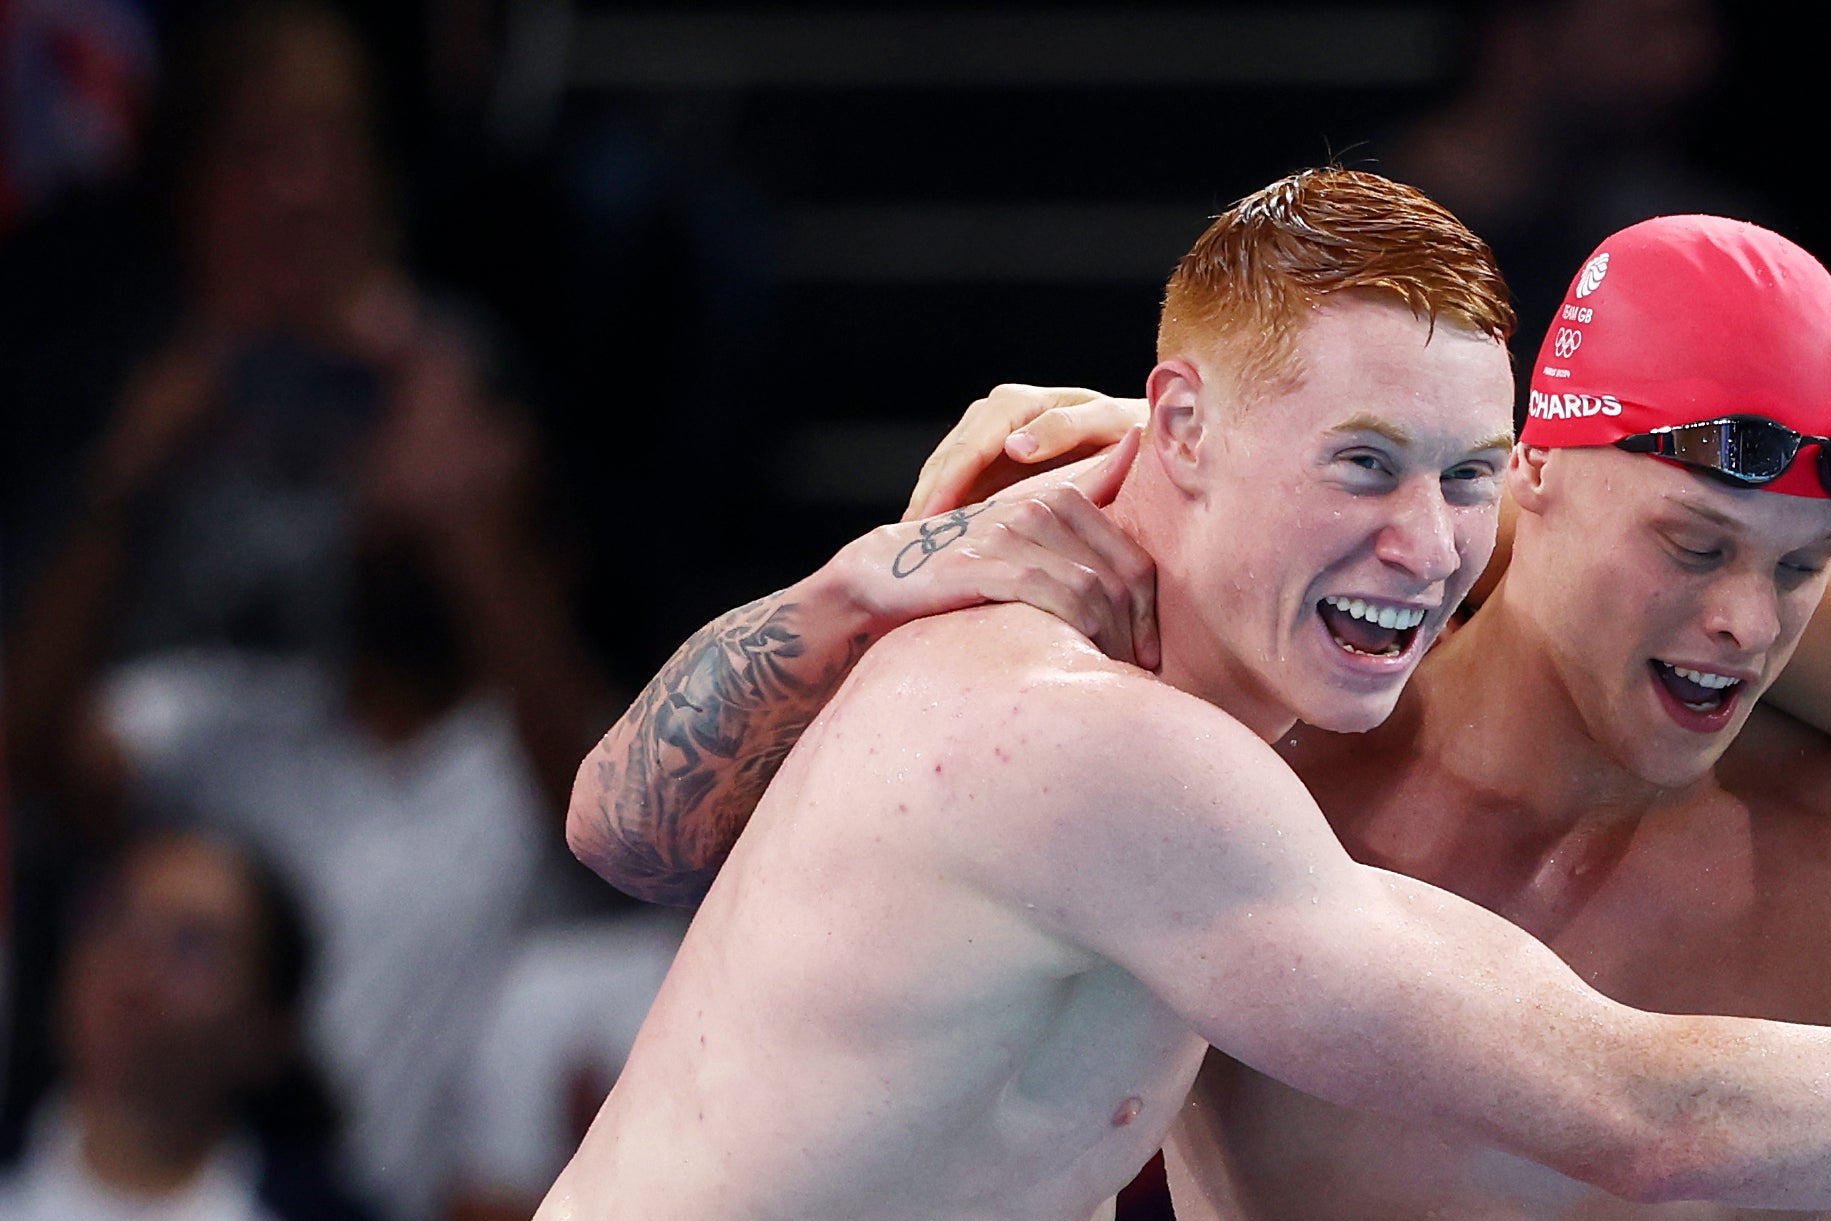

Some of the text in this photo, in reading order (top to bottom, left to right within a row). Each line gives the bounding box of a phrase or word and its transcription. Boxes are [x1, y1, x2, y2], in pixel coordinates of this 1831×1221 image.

[1562, 304, 1594, 324] TEAM GB
[1529, 389, 1622, 420] CHARDS
